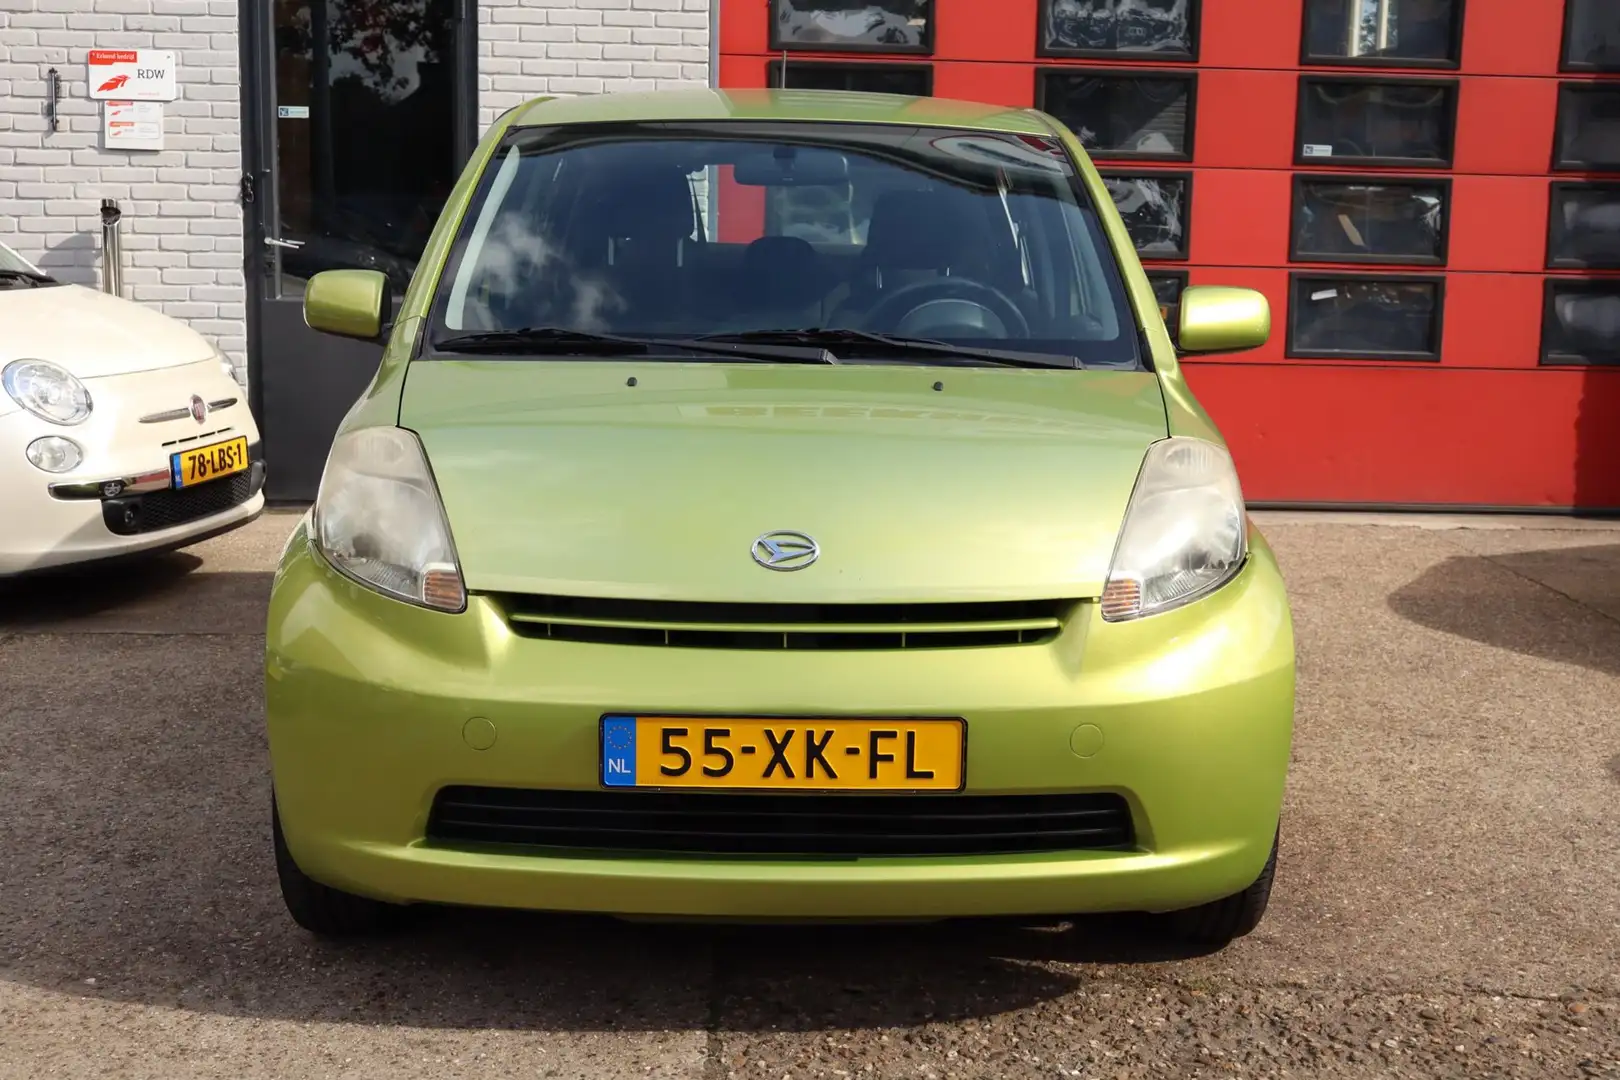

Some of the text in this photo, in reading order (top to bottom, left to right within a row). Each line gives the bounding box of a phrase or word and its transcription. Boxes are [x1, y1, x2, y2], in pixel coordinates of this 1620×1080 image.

[137, 68, 165, 79] RDW
[188, 443, 242, 480] 78-LBS-1
[608, 758, 631, 774] NL
[660, 727, 935, 780] 55-XK-FL
